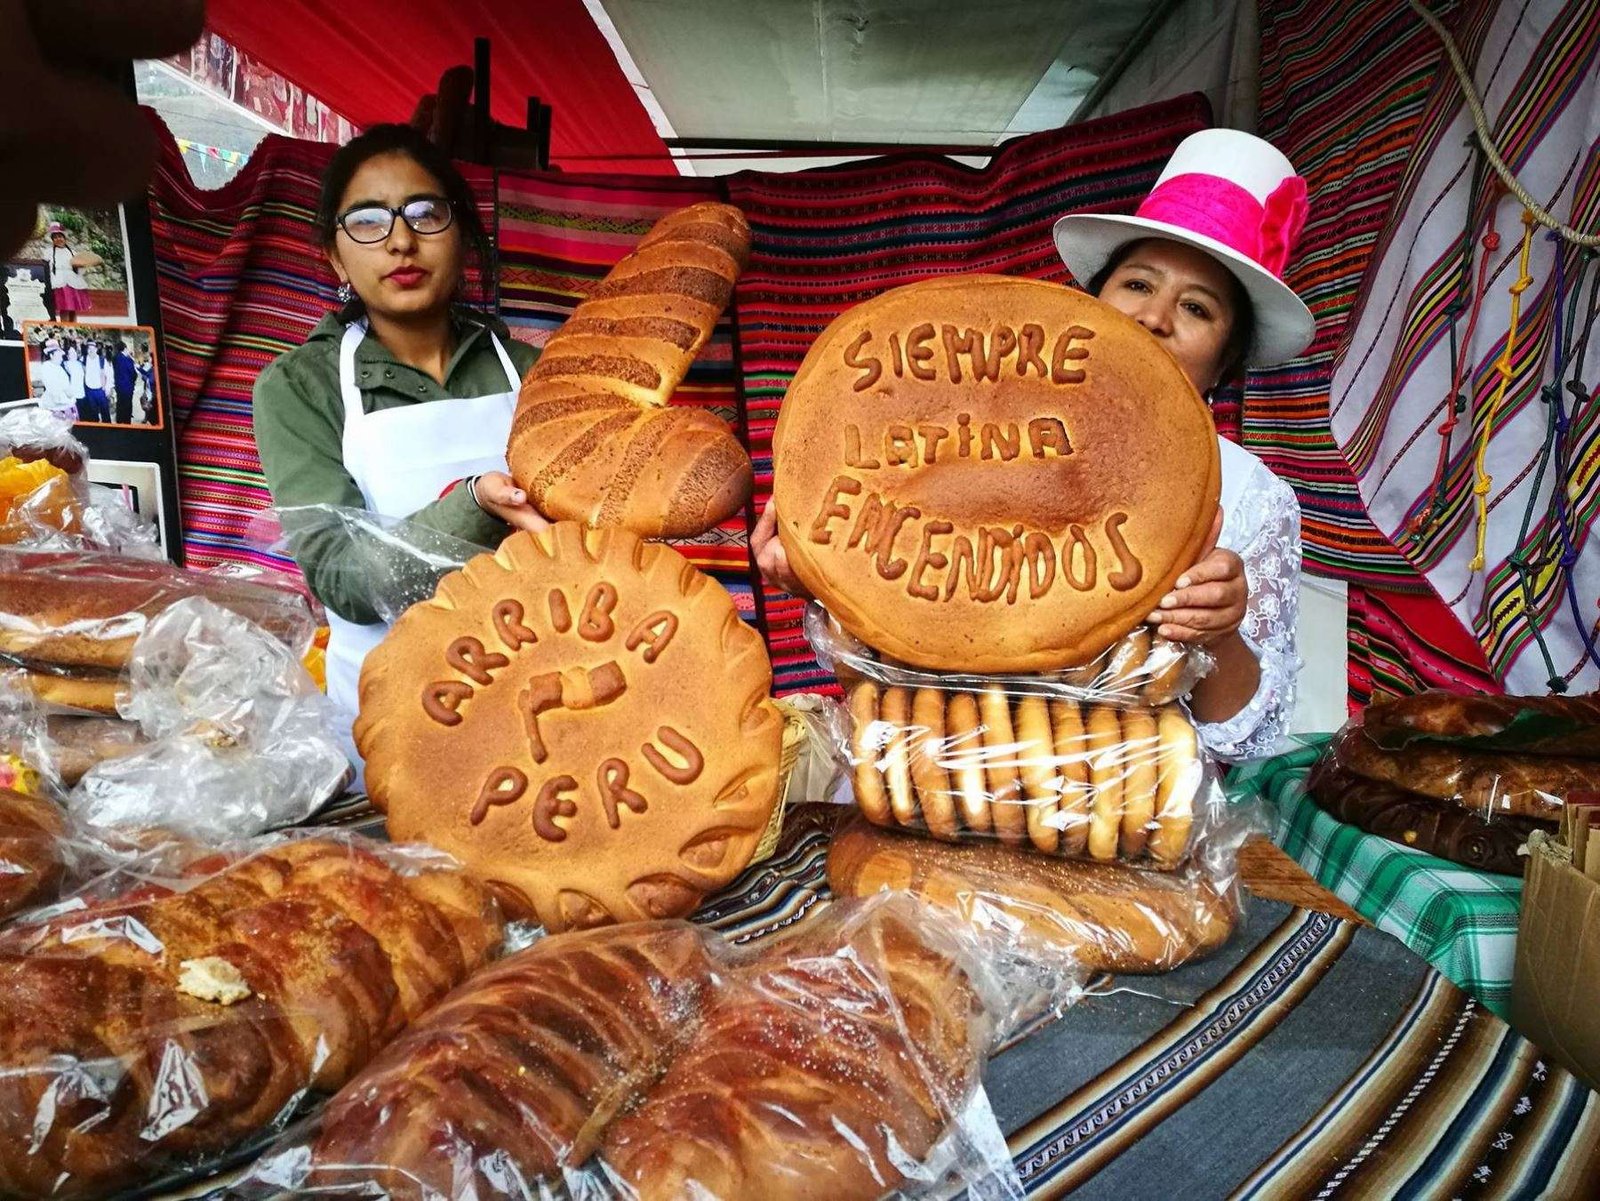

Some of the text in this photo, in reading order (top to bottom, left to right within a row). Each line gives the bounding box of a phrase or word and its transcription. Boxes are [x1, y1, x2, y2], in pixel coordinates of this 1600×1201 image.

[843, 322, 1095, 392] SIEMPRE
[421, 581, 680, 727] ARRIBA
[469, 725, 705, 843] PERU
